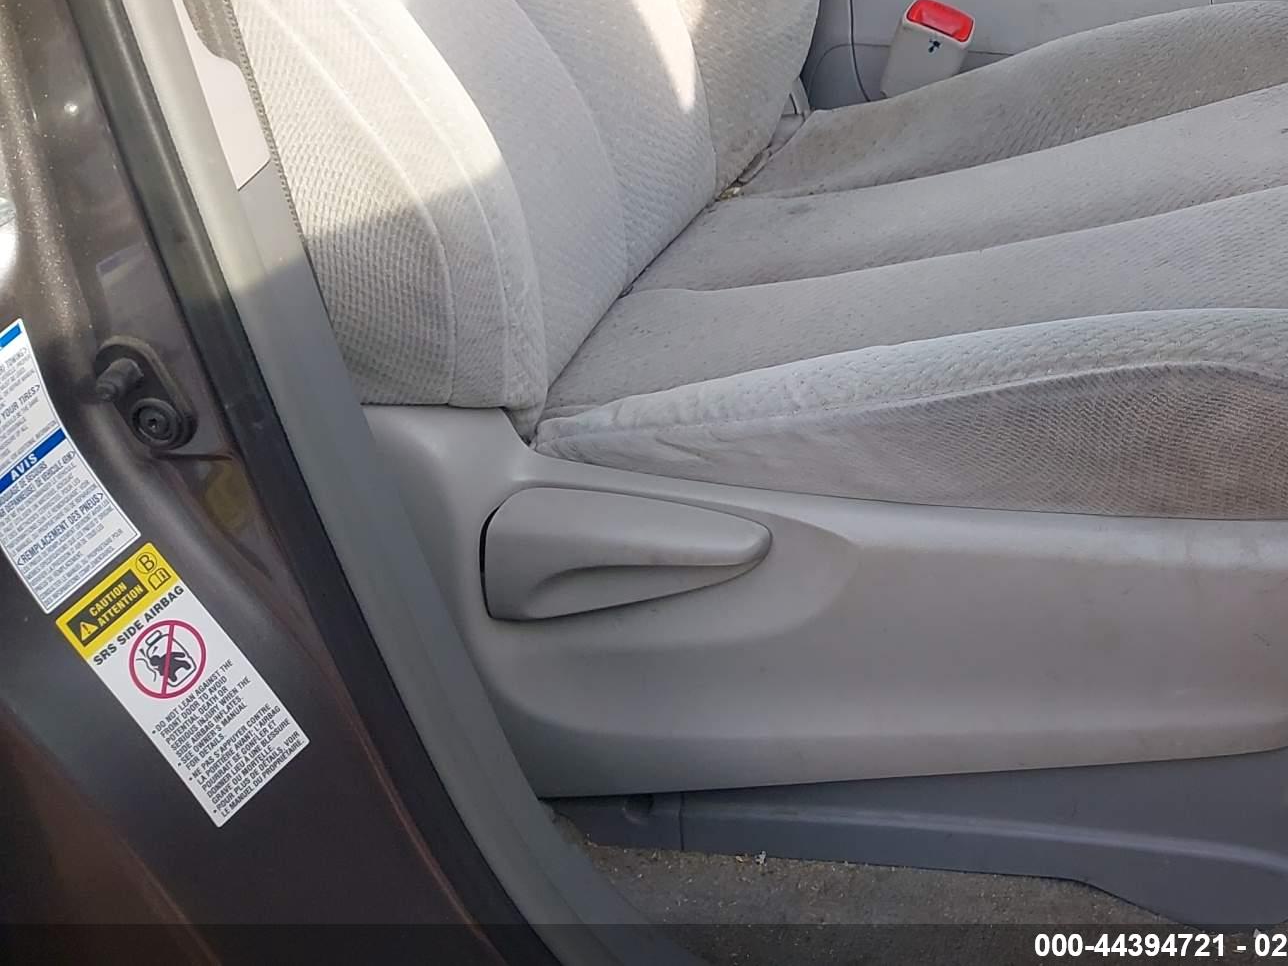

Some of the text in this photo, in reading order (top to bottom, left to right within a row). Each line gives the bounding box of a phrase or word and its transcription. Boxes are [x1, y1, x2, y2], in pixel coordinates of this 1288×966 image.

[10, 453, 39, 481] AVIS
[67, 510, 82, 525] DES
[90, 583, 127, 616] CAUTION
[94, 586, 184, 665] SRS SIDE AIRBAG
[98, 585, 143, 626] ATTENTION
[155, 660, 233, 732] DO NOT LEAN AGAINST THE
[160, 676, 227, 738] FRONT DOOR TO AVOID
[166, 686, 229, 745] POTENTIAL DEATH OR
[171, 677, 251, 751] SERIOUS INJURY WHEN THE
[176, 742, 192, 758] SIDE
[191, 721, 215, 744] AIRBAG
[181, 703, 247, 764] SEE OWNER'S MANUAL
[186, 756, 200, 771] FOR
[192, 705, 271, 778] NE PAS S'APPUYER CONTRE
[197, 775, 207, 785] LA
[254, 706, 281, 732] L'AIRBAG
[202, 720, 276, 791] POURRAIT SE GONFLER ET
[207, 773, 232, 798] DONNER
[231, 761, 245, 776] LIEU
[249, 745, 262, 758] UNE
[261, 719, 290, 747] BLESSURE
[212, 784, 232, 804] GRAVE
[232, 774, 243, 785] OU
[216, 793, 235, 811] POUR
[234, 778, 251, 795] PLUS
[250, 769, 259, 780] DE
[284, 731, 300, 746] VOIR
[221, 808, 230, 818] LE
[229, 786, 254, 810] MANUEL
[253, 776, 263, 787] DU
